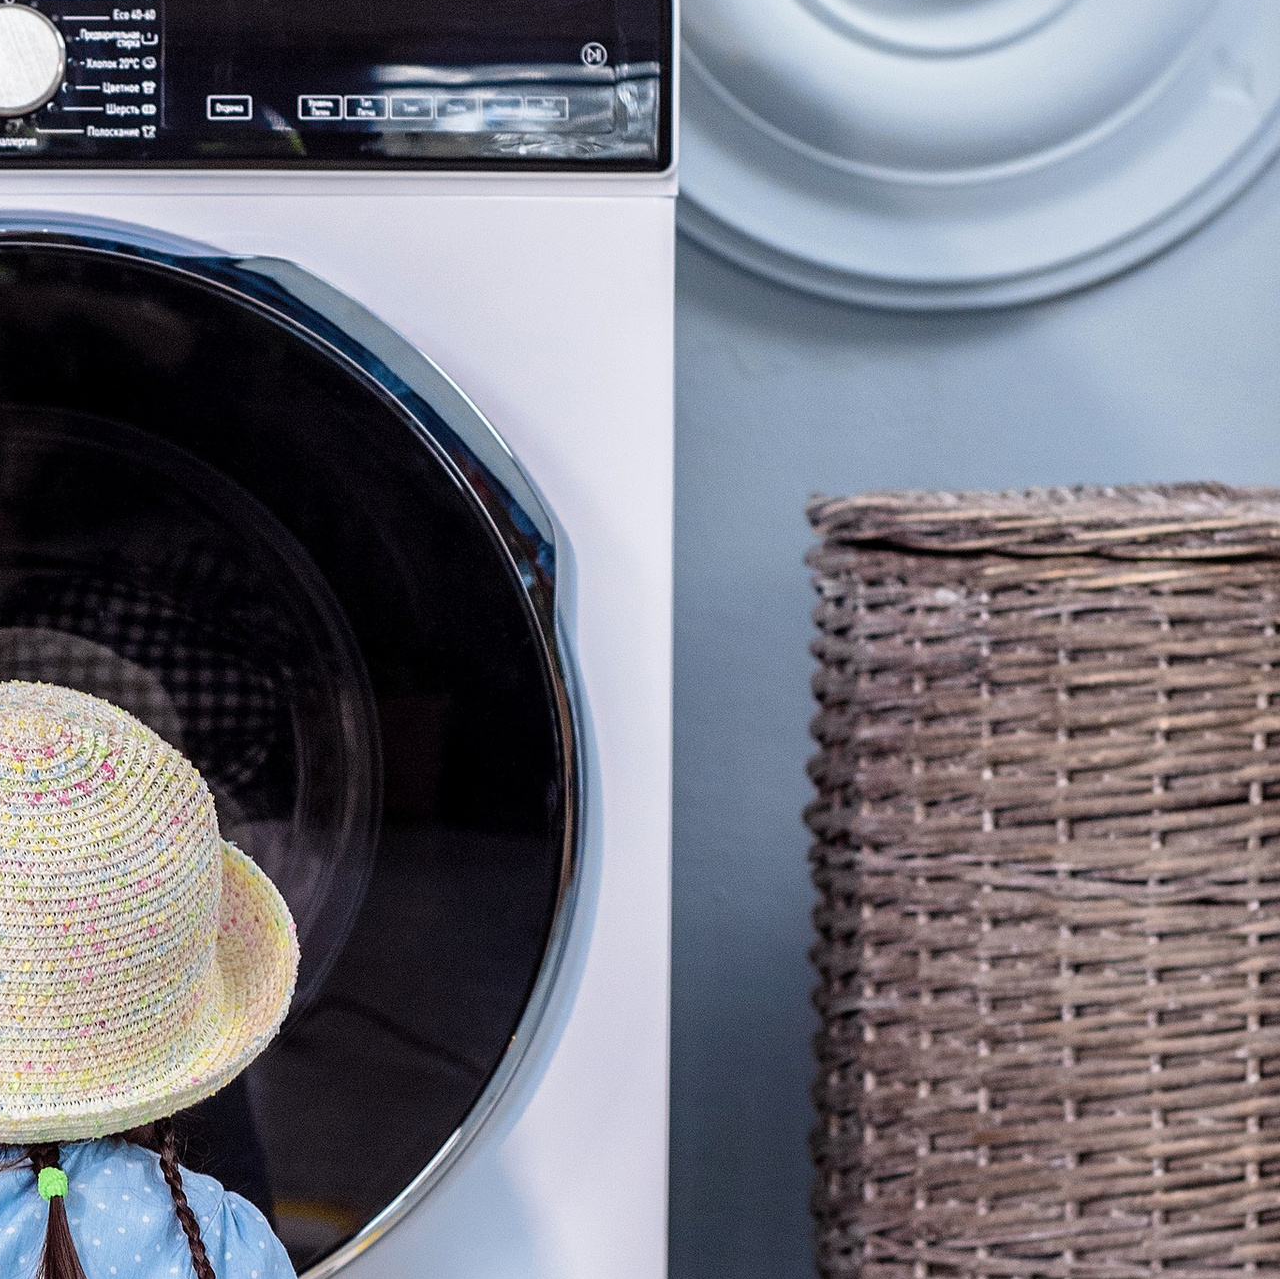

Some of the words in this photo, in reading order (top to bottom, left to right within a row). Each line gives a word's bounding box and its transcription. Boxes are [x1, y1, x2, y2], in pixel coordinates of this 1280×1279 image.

[113, 8, 130, 21] Eco
[102, 81, 141, 95] Цветное
[105, 103, 141, 117] Шерсть
[86, 125, 141, 137] Полоскание
